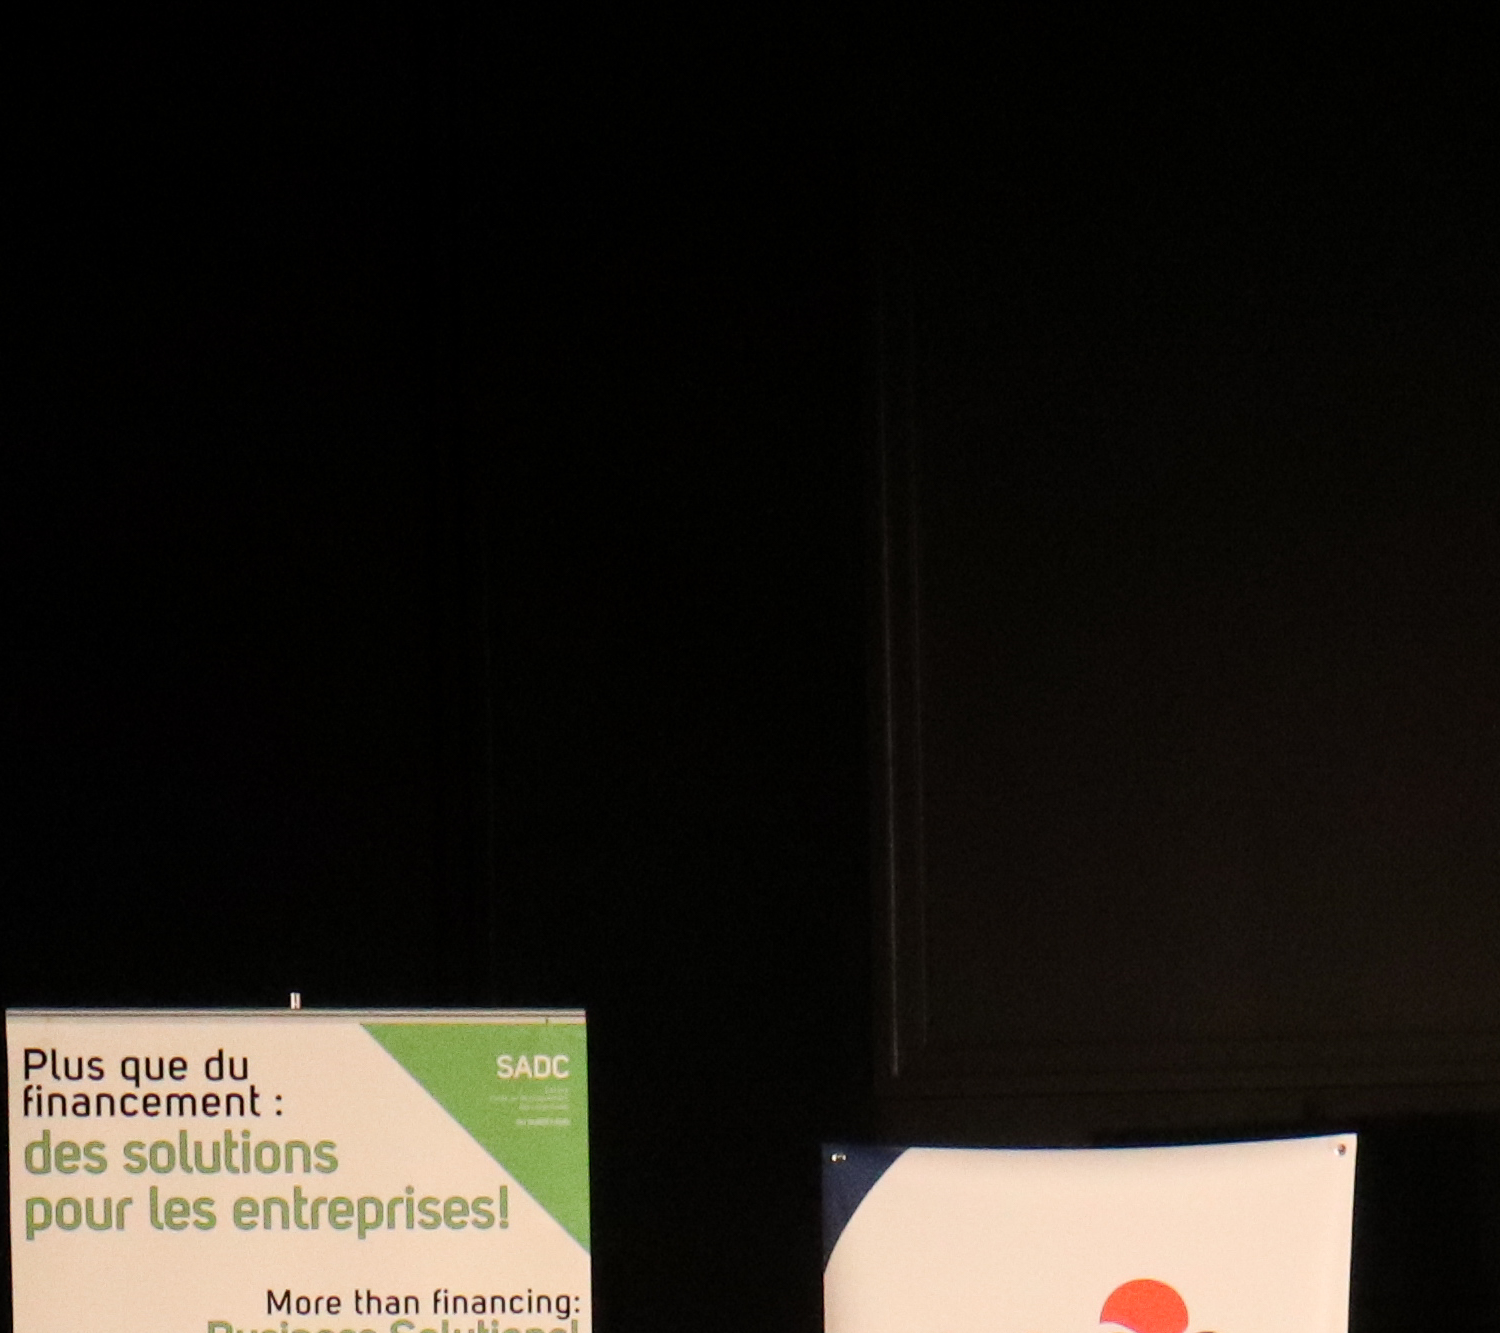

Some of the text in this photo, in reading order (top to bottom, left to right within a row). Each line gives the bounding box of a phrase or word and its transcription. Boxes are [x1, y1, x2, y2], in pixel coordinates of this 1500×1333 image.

[24, 1048, 248, 1088] Plus que du
[497, 1054, 569, 1079] SADC
[24, 1084, 260, 1117] financement
[24, 1129, 338, 1175] des solutions
[25, 1185, 509, 1241] pour les entreprises!
[267, 1289, 579, 1320] More than financing:
